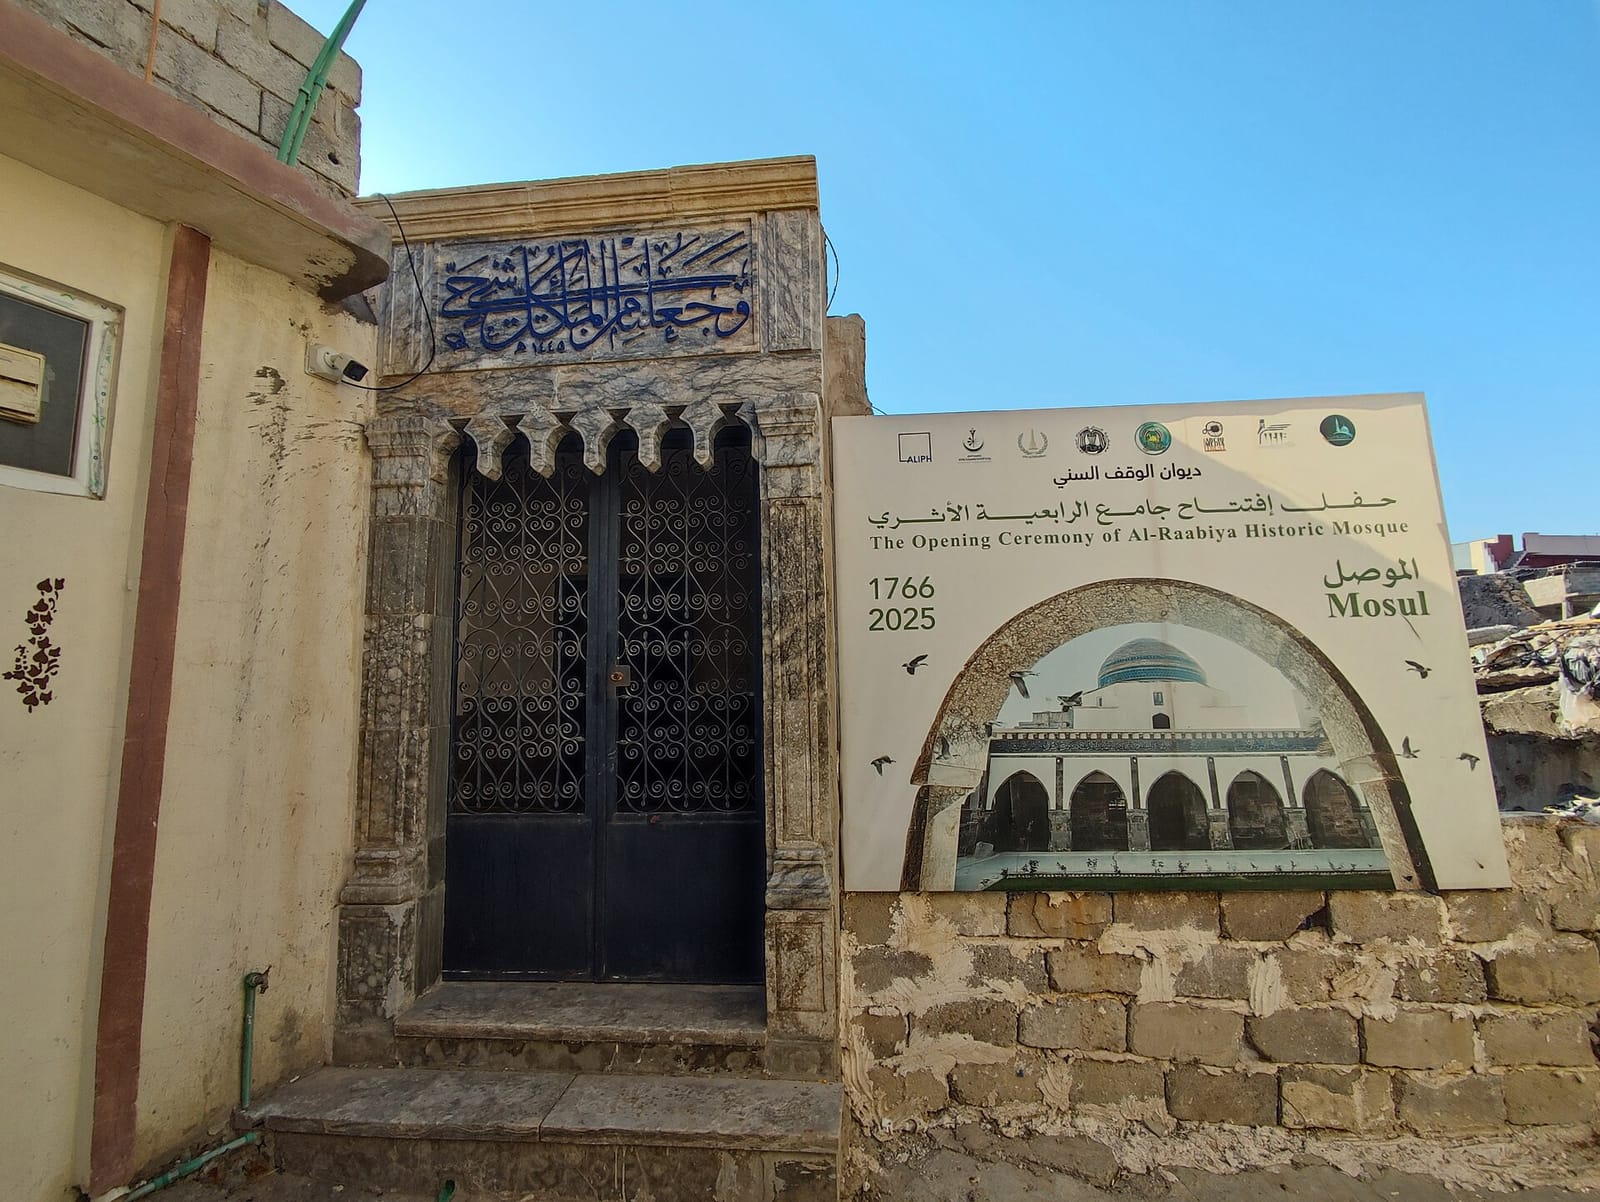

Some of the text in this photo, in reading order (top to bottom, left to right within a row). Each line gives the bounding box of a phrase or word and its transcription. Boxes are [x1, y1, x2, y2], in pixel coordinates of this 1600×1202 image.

[906, 455, 932, 463] ALIPH
[1053, 464, 1202, 488] ديوان الوقف السني
[1096, 499, 1170, 525] جامع
[870, 520, 1409, 552] The Opening Ceremony of Al-Raabiya Historic Mosque
[1323, 557, 1419, 589] الموصل
[869, 576, 935, 600] 1766
[1324, 590, 1431, 618] Mosul
[868, 607, 936, 631] 2025
